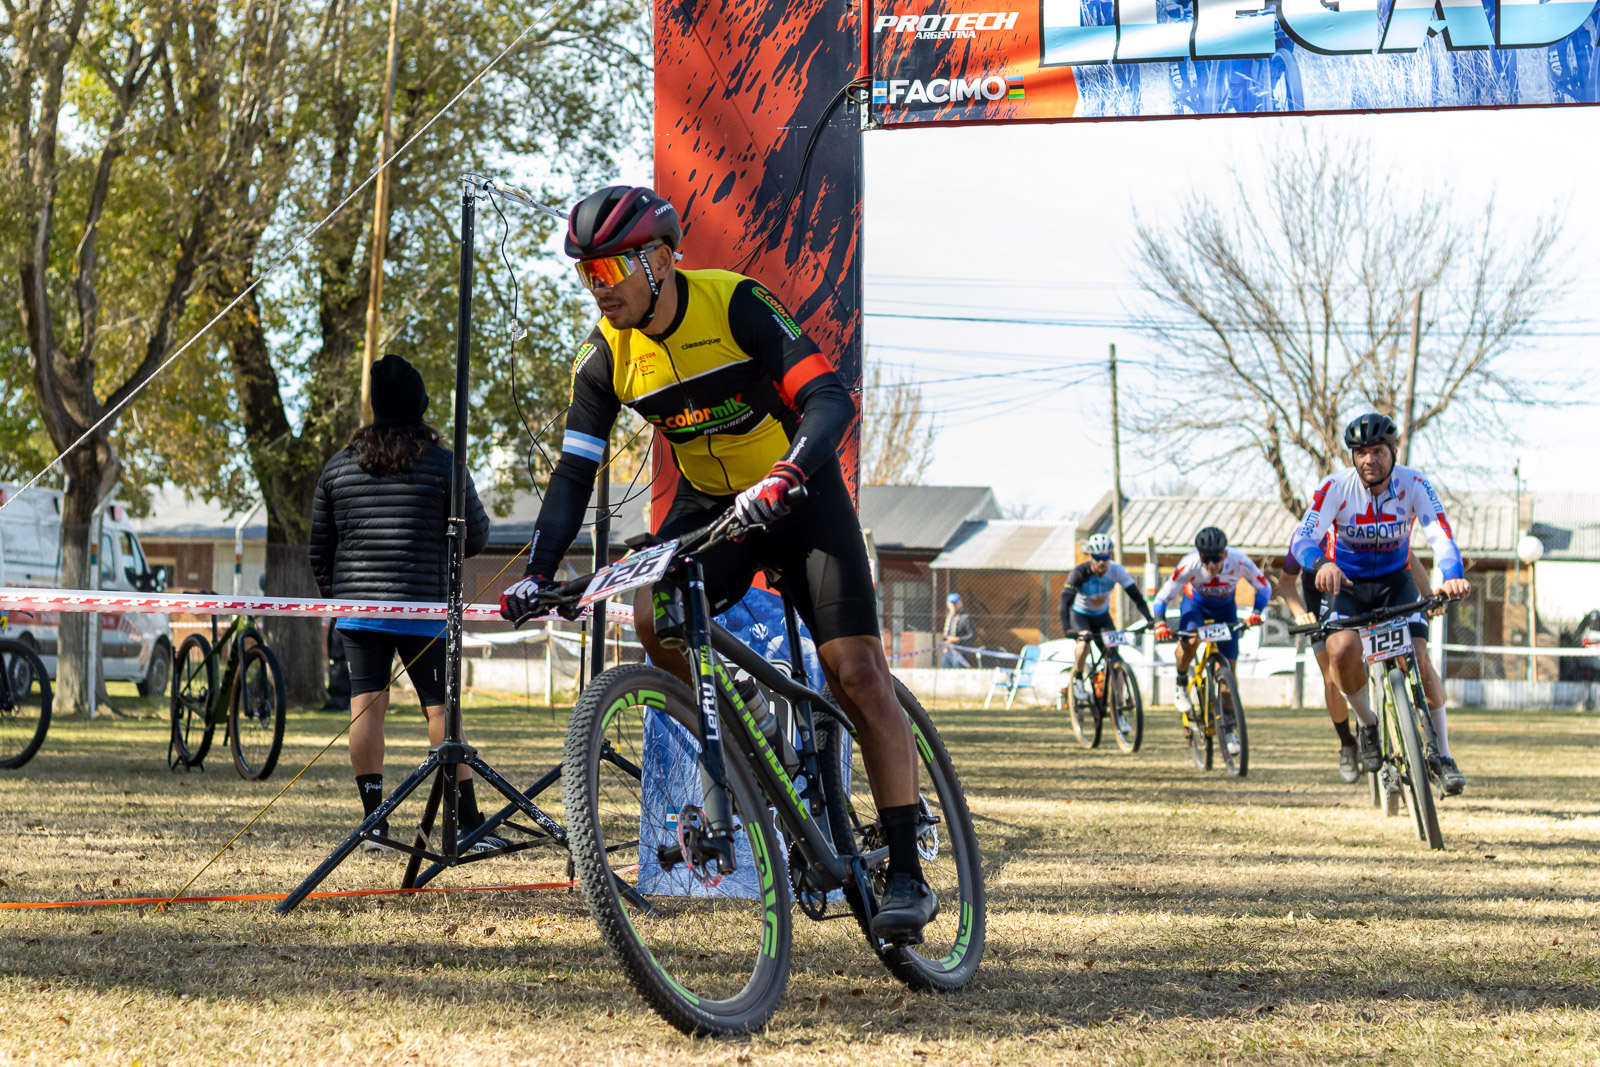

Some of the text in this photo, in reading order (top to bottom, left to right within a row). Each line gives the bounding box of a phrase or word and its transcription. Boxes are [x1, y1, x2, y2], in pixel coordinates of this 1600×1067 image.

[873, 12, 1020, 33] PROTECH
[914, 30, 977, 40] ARGENTINA
[889, 76, 1007, 104] FACIMO
[681, 338, 721, 350] classique
[703, 409, 754, 436] PINTURERIA
[1421, 479, 1444, 513] GABOTTI
[1346, 520, 1407, 540] GABOTTI
[593, 555, 662, 593] 126
[1369, 628, 1404, 655] 129
[703, 682, 720, 741] Lefty
